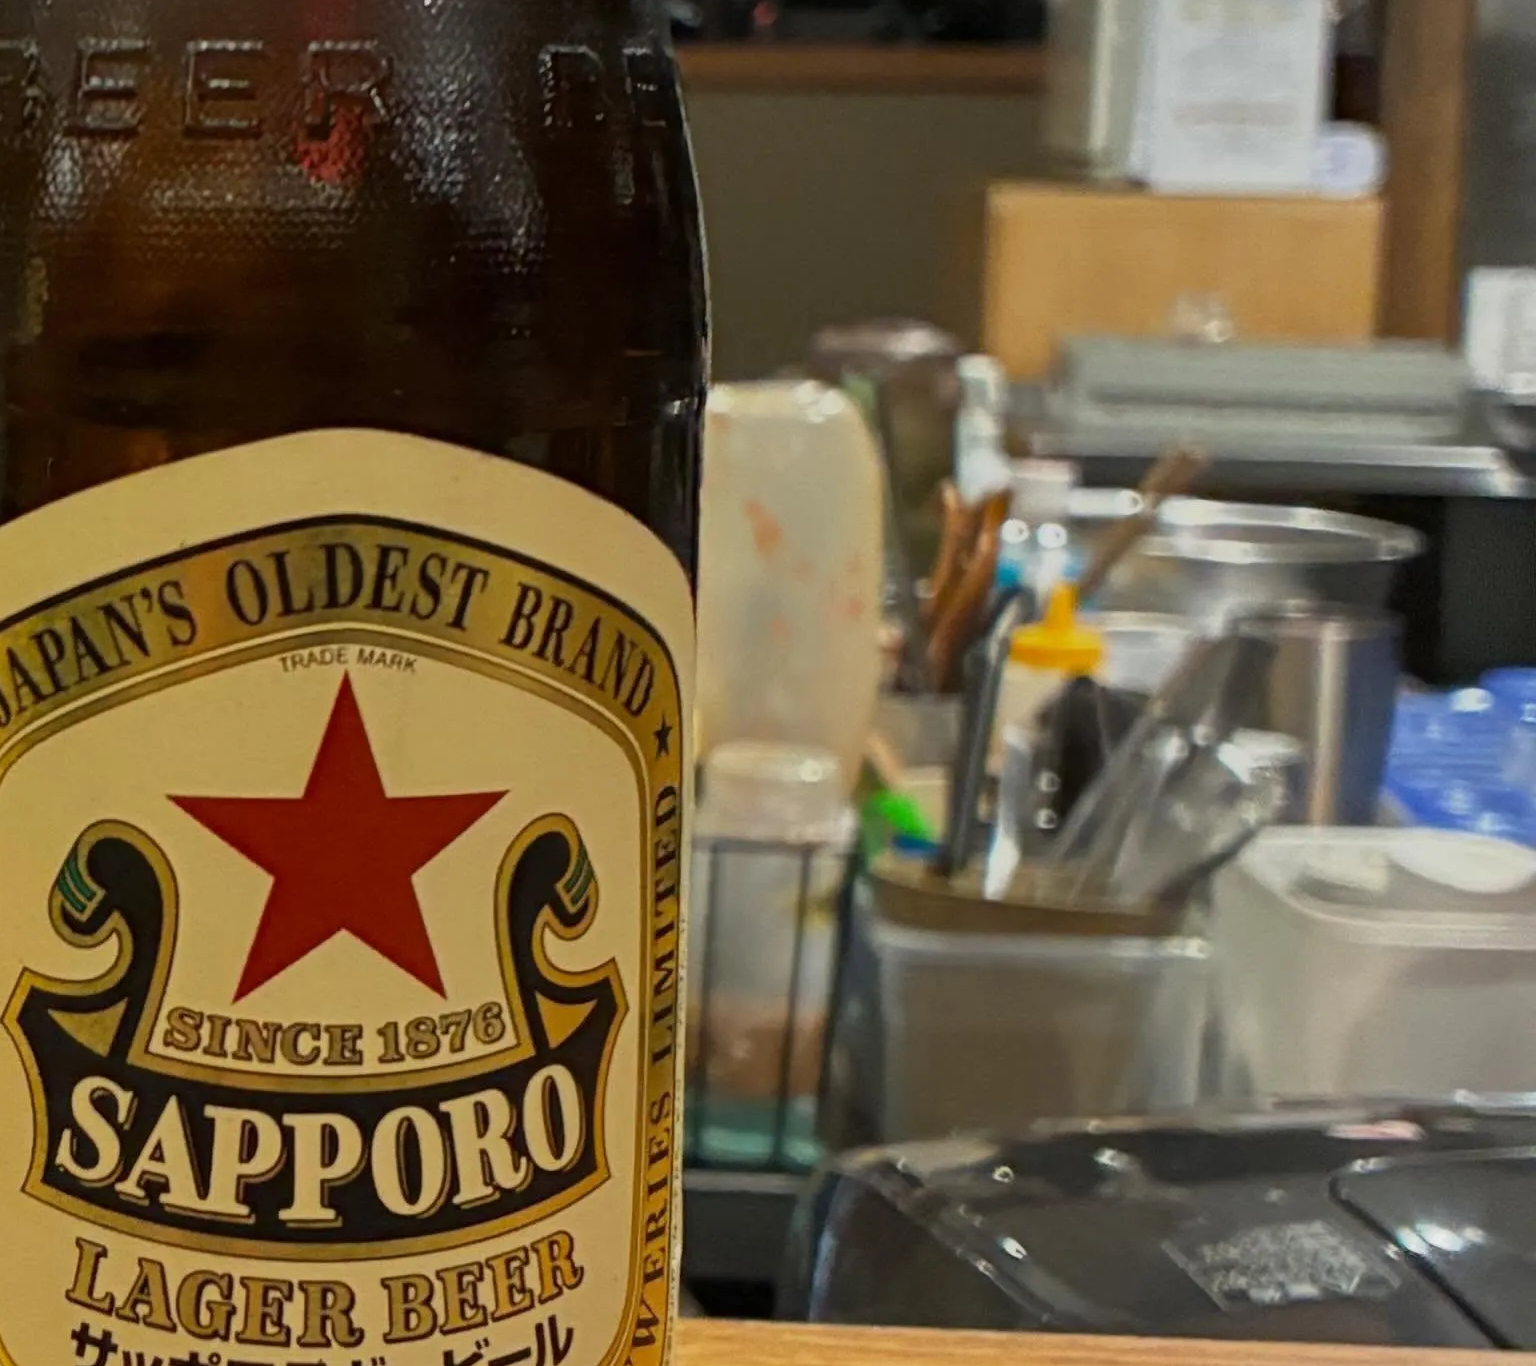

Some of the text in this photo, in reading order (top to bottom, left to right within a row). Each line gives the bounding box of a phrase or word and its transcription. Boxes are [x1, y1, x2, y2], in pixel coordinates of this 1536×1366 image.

[225, 541, 490, 633] OLDEST
[498, 580, 656, 719] BRAND
[278, 645, 418, 673] TRADE MARK
[162, 1000, 507, 1067] SINCE 1876
[54, 1062, 588, 1230] SAPPORO
[65, 1237, 365, 1348] LAGER
[383, 1229, 585, 1344] BEER
